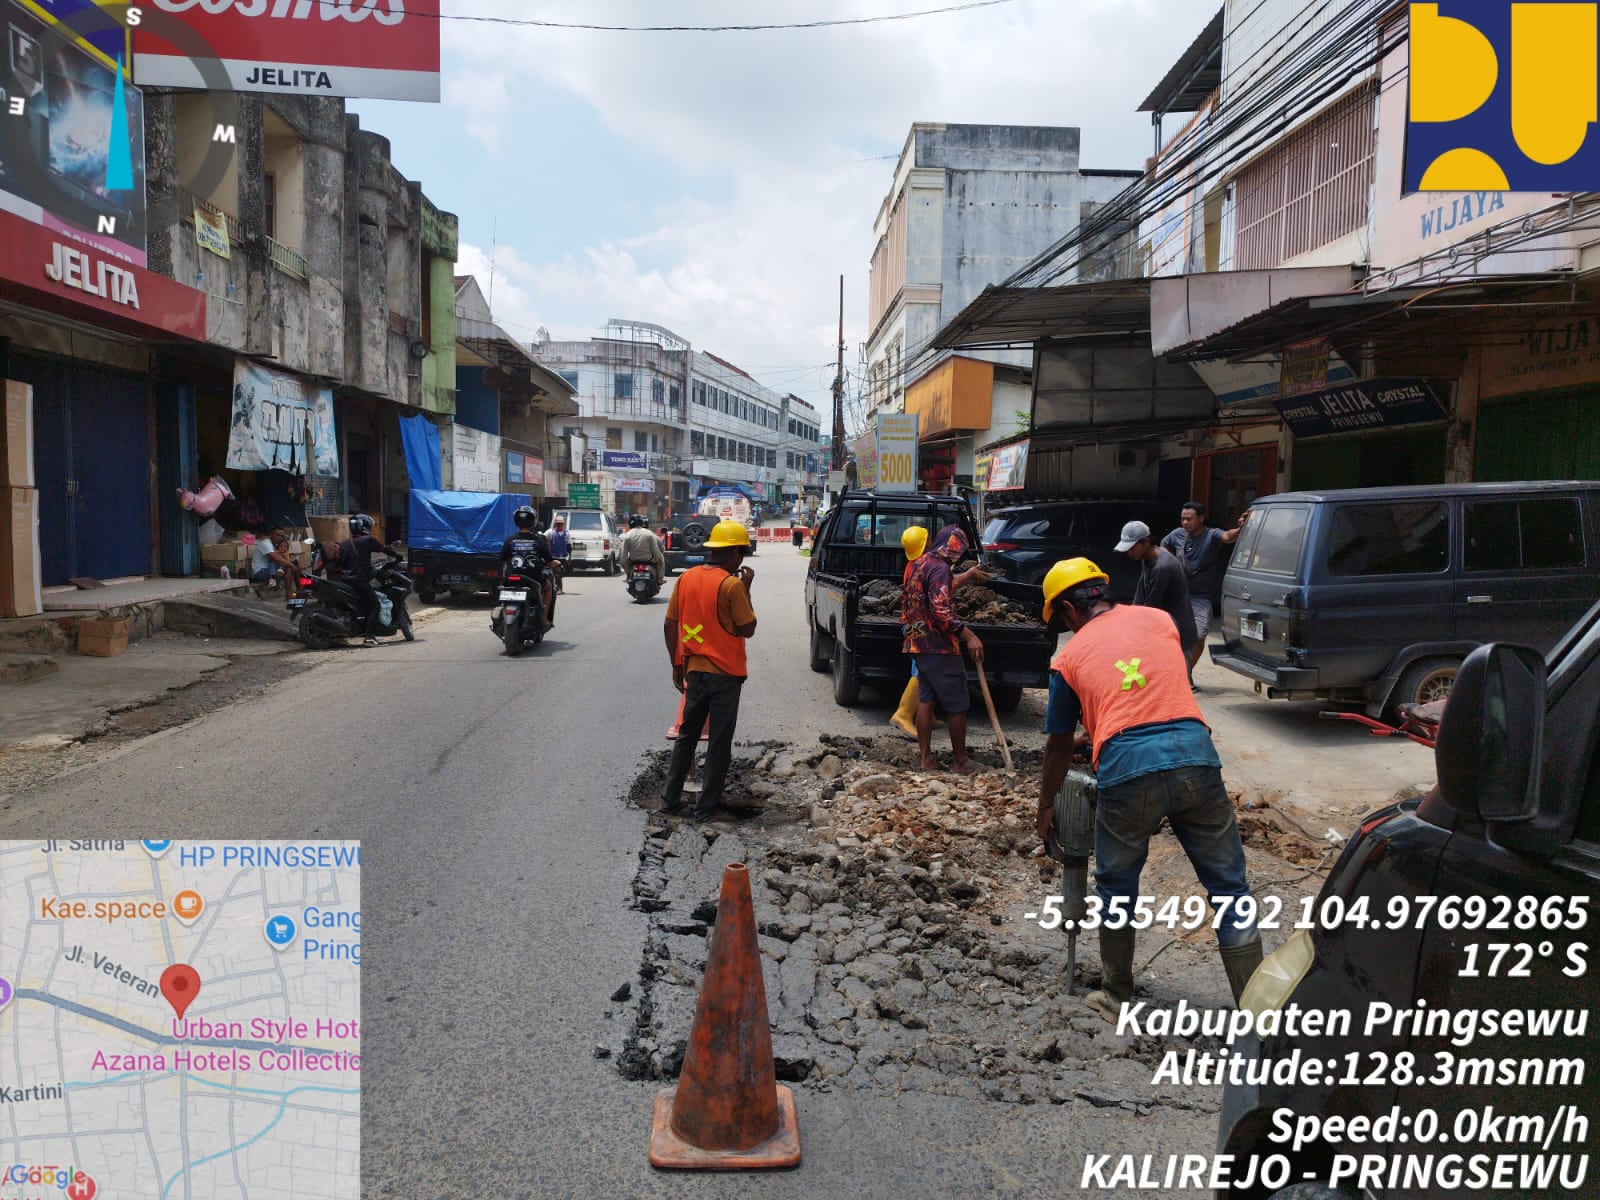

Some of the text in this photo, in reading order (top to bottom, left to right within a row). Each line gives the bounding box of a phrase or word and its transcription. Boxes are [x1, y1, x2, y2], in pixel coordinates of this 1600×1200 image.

[246, 67, 332, 89] JELITA
[1421, 192, 1504, 240] WIJAYA
[45, 242, 140, 309] JELITA
[1526, 318, 1600, 357] WIJA
[1319, 388, 1376, 417] JELITA
[1376, 383, 1425, 404] CRYSTAL
[881, 452, 912, 484] 5000
